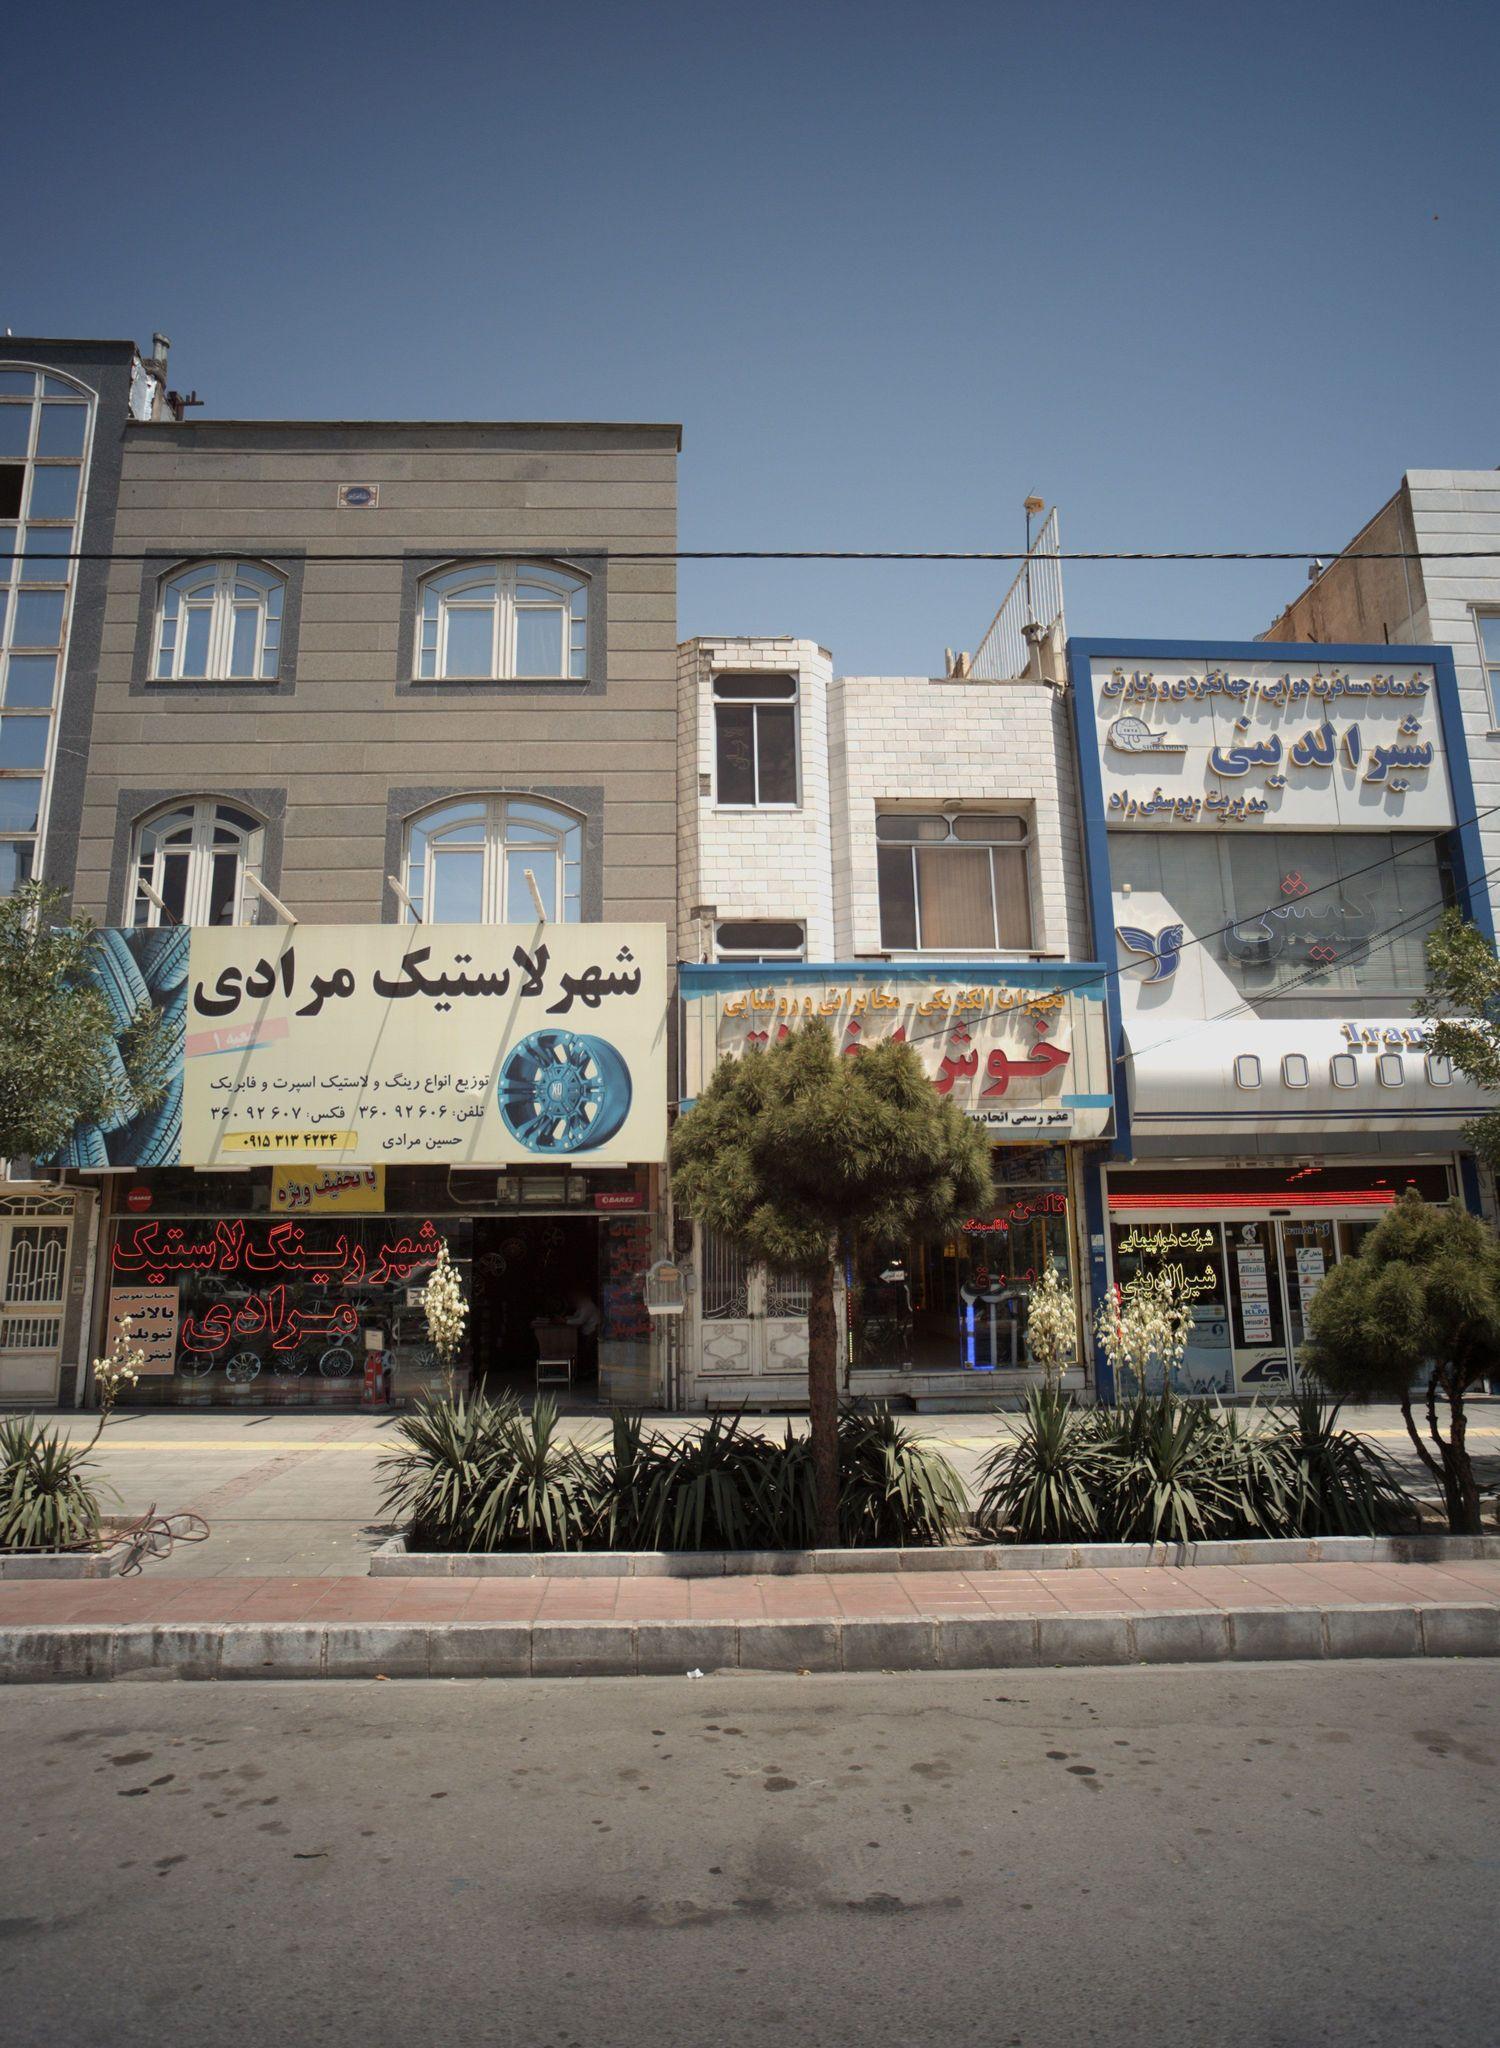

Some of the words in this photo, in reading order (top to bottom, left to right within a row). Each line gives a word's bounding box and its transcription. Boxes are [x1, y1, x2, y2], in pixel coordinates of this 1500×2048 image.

[1159, 680, 1170, 701] و
[1172, 667, 1251, 701] جهانگردی
[1312, 668, 1372, 704] مسافرت
[1371, 671, 1431, 697] خدمات
[193, 945, 356, 1017] مرادی
[804, 996, 812, 1016] و
[818, 985, 901, 1016] مخابراتی
[917, 987, 994, 1020] الکتریکی
[998, 985, 1066, 1018] تجهیزات
[1341, 1021, 1425, 1044] Iran
[209, 1075, 257, 1093] فابریک
[261, 1079, 268, 1092] و
[272, 1075, 316, 1095] اسپرت
[320, 1074, 368, 1092] لاستیک
[373, 1079, 380, 1092] و
[385, 1072, 420, 1092] رینگ
[424, 1073, 451, 1094] انواع
[455, 1073, 490, 1094] توزیع
[245, 1105, 266, 1120] ۹۲
[306, 1106, 346, 1124] فکس:
[394, 1105, 414, 1120] ۹۲
[452, 1106, 485, 1123] تلفن:
[1010, 1113, 1044, 1126] رسمی
[1047, 1111, 1069, 1125] عضو
[243, 1133, 271, 1149] ۰۹۱۵
[275, 1134, 300, 1148] ۳۱۳
[303, 1133, 339, 1148] ۴۲۳۴
[381, 1133, 422, 1151] مرادی
[425, 1134, 463, 1149] حسین
[278, 1181, 312, 1208] ویژه
[1118, 1229, 1179, 1254] هواپیمایی
[1179, 1228, 1214, 1252] شرکت
[112, 1219, 246, 1284] لاستیک
[246, 1222, 366, 1285] رینگ
[368, 1220, 443, 1284] شهر
[181, 1284, 359, 1353] مرادی
